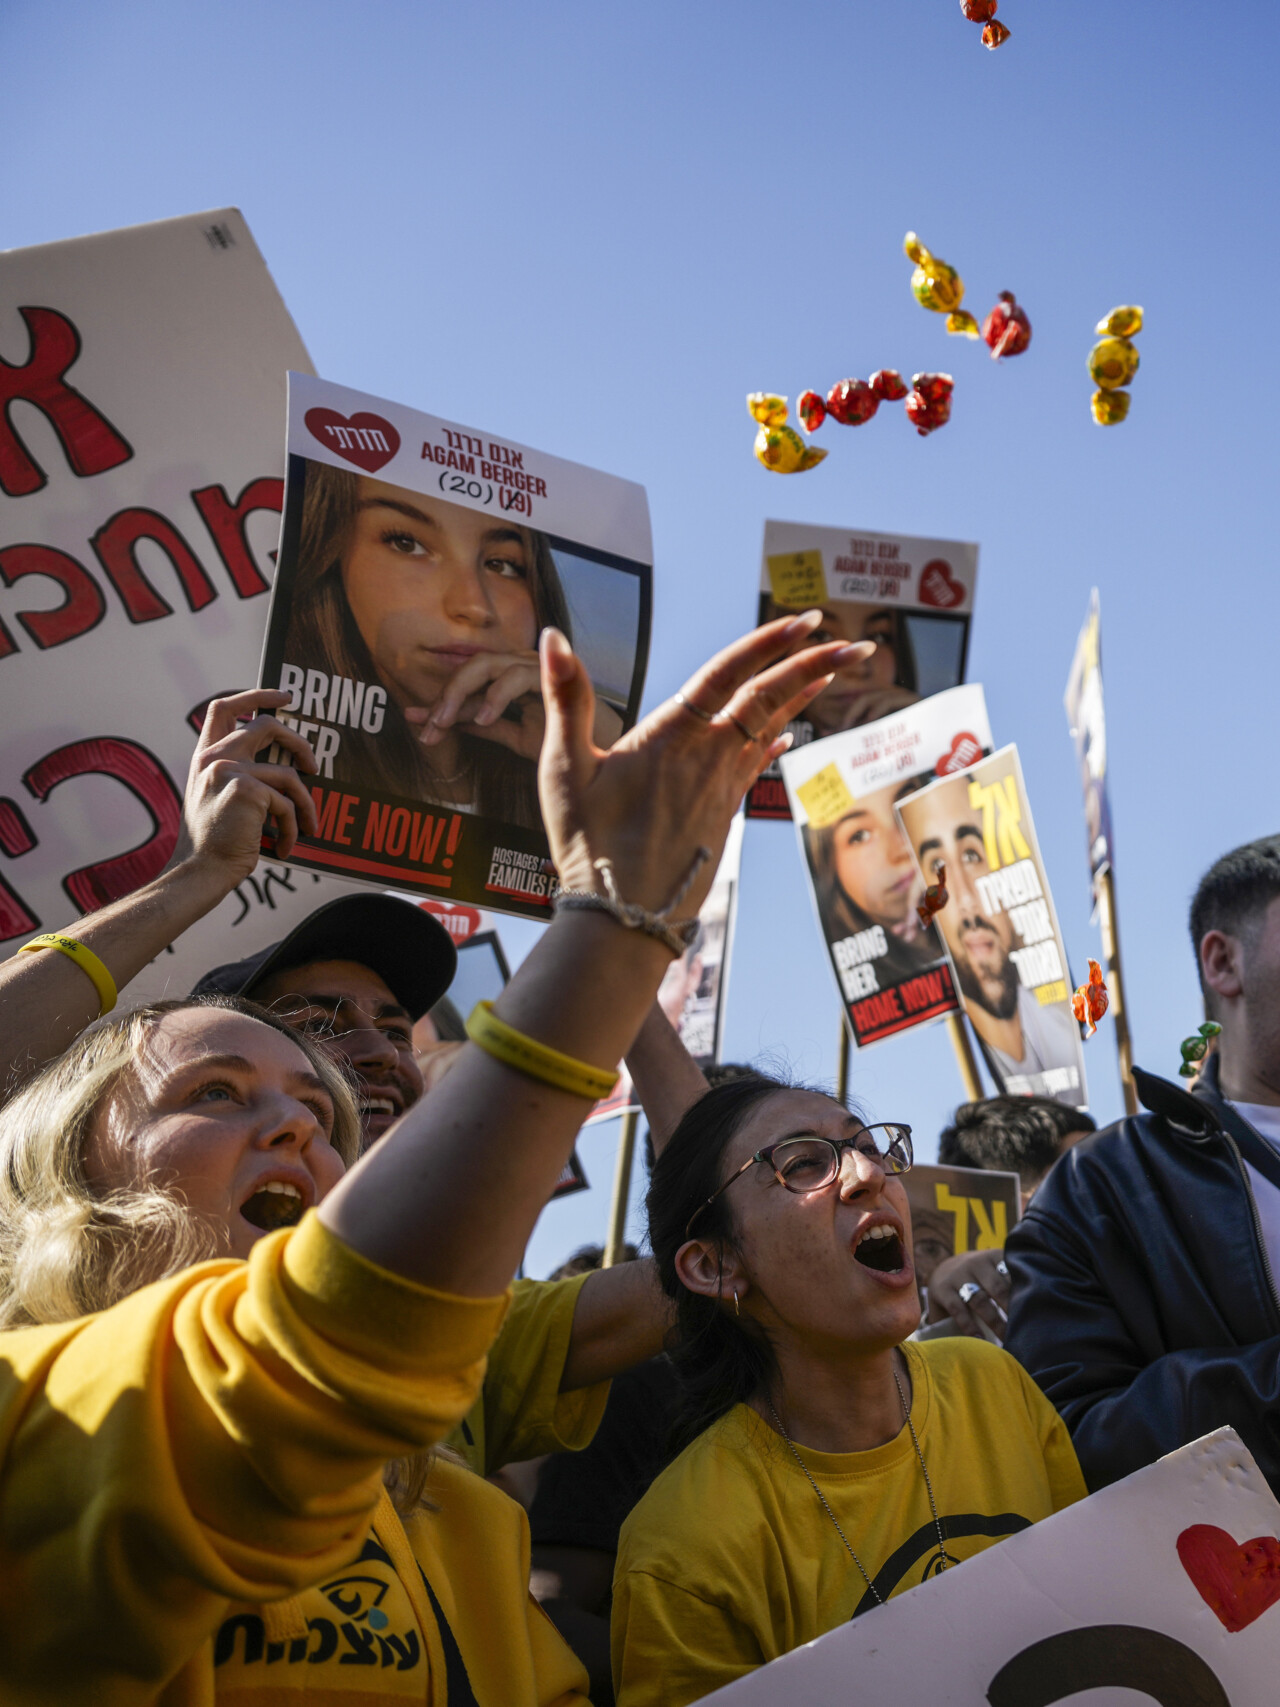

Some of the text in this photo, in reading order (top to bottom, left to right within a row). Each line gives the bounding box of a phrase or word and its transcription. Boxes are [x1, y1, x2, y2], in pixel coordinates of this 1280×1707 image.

[324, 425, 391, 452] חזרתי
[441, 428, 524, 470] אגם ברגר
[421, 441, 547, 498] AGAM BERGER
[438, 471, 493, 505] (20)
[279, 663, 387, 734] BRING
[362, 801, 462, 869] NOW!
[968, 774, 1031, 871] אל
[488, 862, 547, 896] FAMILIES
[492, 846, 539, 871] HOSTAGES
[850, 988, 904, 1033] HOME
